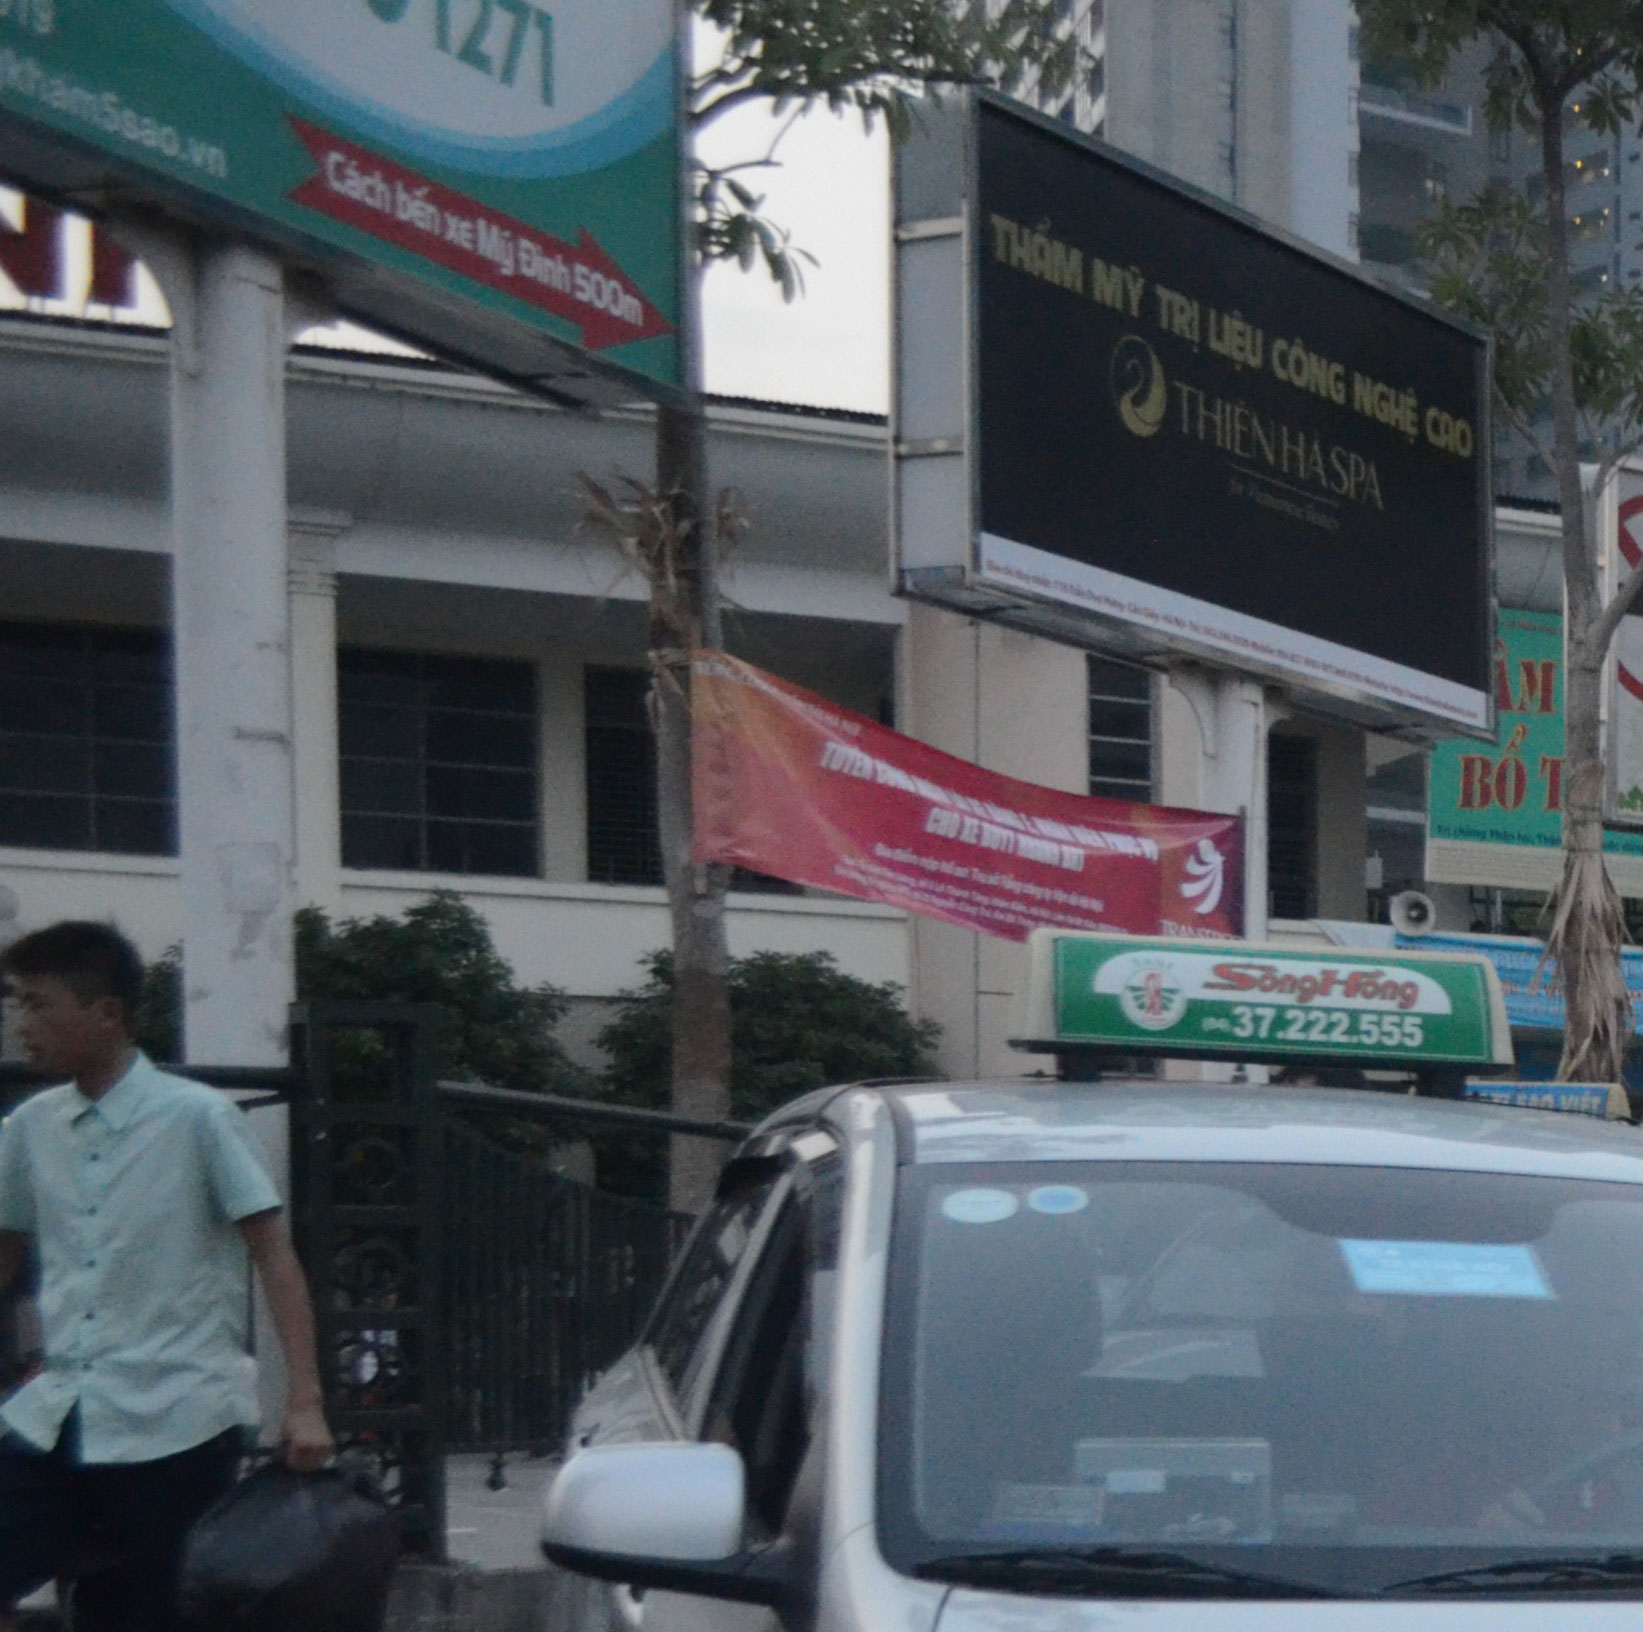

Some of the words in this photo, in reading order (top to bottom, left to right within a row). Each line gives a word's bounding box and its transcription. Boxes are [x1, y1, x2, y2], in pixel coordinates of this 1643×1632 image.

[326, 152, 391, 212] Cách
[396, 186, 441, 234] bến
[446, 213, 473, 250] xe
[518, 240, 572, 292] Đình
[574, 266, 644, 326] 500m
[1155, 284, 1201, 354] TRỊ
[1208, 308, 1264, 372] LIỆU
[1272, 337, 1347, 405] CÔNG
[1353, 370, 1419, 444] NGHỆ
[1425, 405, 1474, 458] CAO
[1173, 379, 1275, 466] THIÊN
[1330, 446, 1385, 511] SPA
